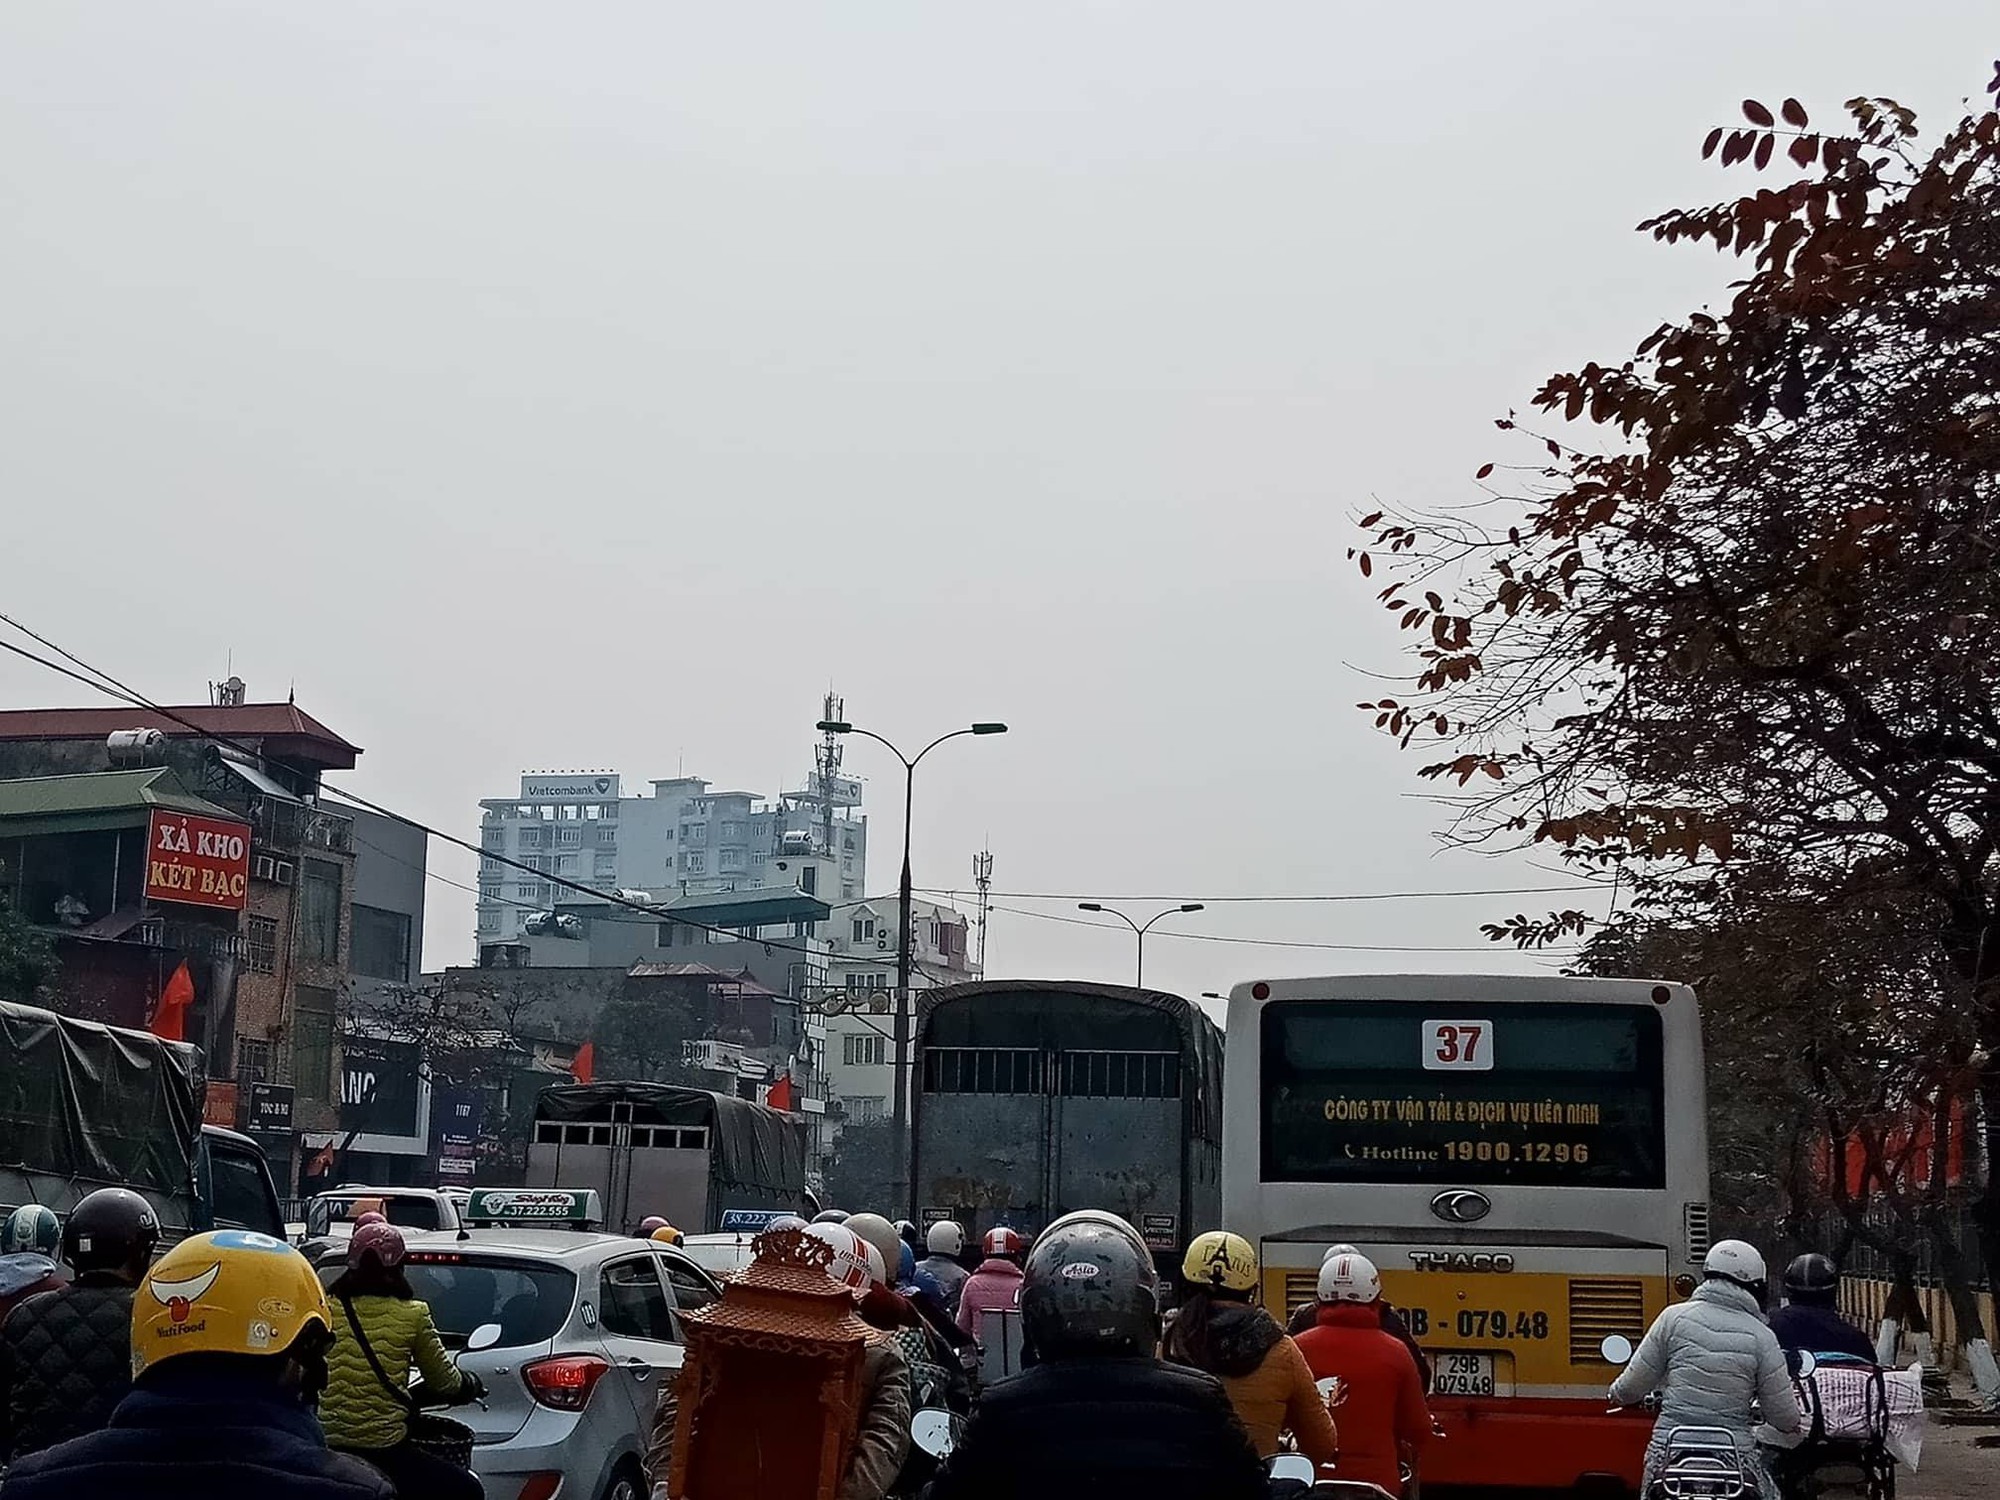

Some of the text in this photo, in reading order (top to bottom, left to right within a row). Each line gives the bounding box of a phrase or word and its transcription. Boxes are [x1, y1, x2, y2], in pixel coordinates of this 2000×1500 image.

[528, 785, 595, 796] Vietcombank
[157, 817, 244, 860] XẢ KHO
[149, 857, 245, 901] KÉT BẠC
[1436, 1025, 1482, 1063] 37
[1324, 1095, 1368, 1121] CÔNG
[1371, 1100, 1390, 1121] TY
[1396, 1095, 1424, 1128] VẬN
[1428, 1092, 1451, 1122] TẢI
[1454, 1101, 1465, 1121] &
[1510, 1102, 1530, 1131] VỤ
[1566, 1103, 1599, 1125] NINH
[1362, 1141, 1589, 1163] Hotline 1900.1296
[510, 1206, 569, 1216] 37.222.555
[1409, 1252, 1514, 1272] THACO
[1457, 1310, 1549, 1339] 079.48
[1449, 1356, 1479, 1374] 29B
[1438, 1376, 1491, 1394] 079.48
